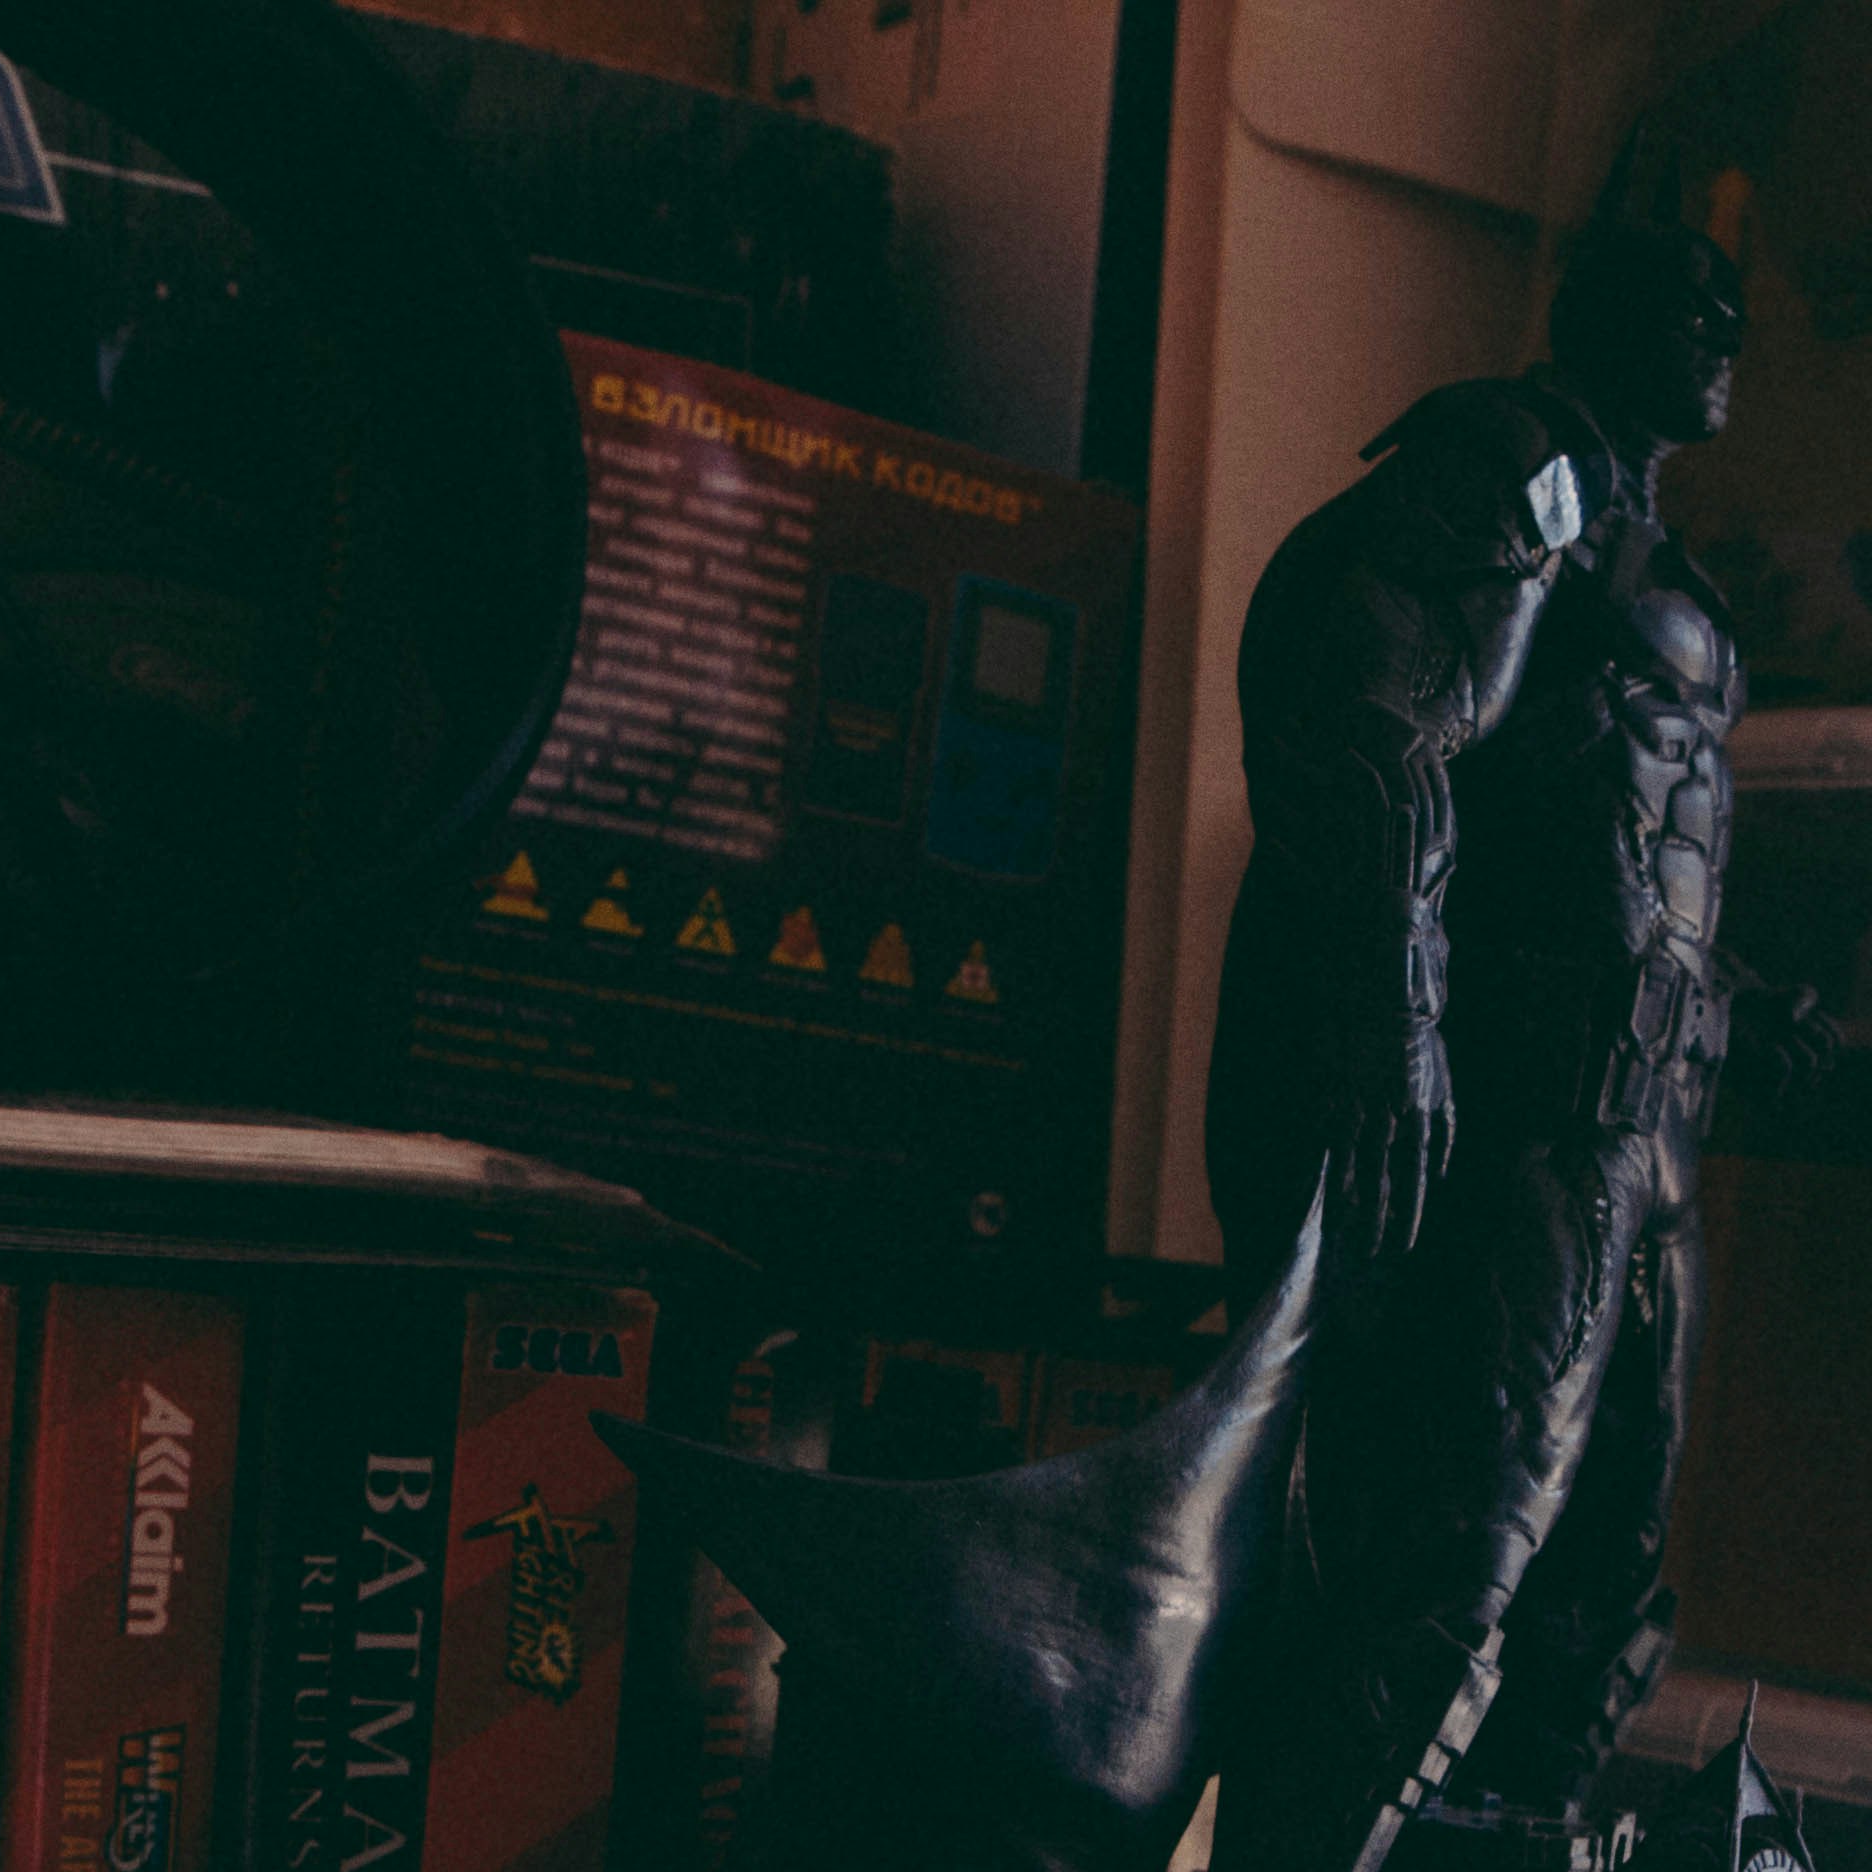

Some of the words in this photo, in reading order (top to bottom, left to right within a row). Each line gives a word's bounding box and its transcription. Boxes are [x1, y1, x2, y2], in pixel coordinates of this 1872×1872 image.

[494, 1324, 622, 1379] SEGA
[286, 1554, 339, 1870] RETURNS
[61, 1756, 104, 1821] THE
